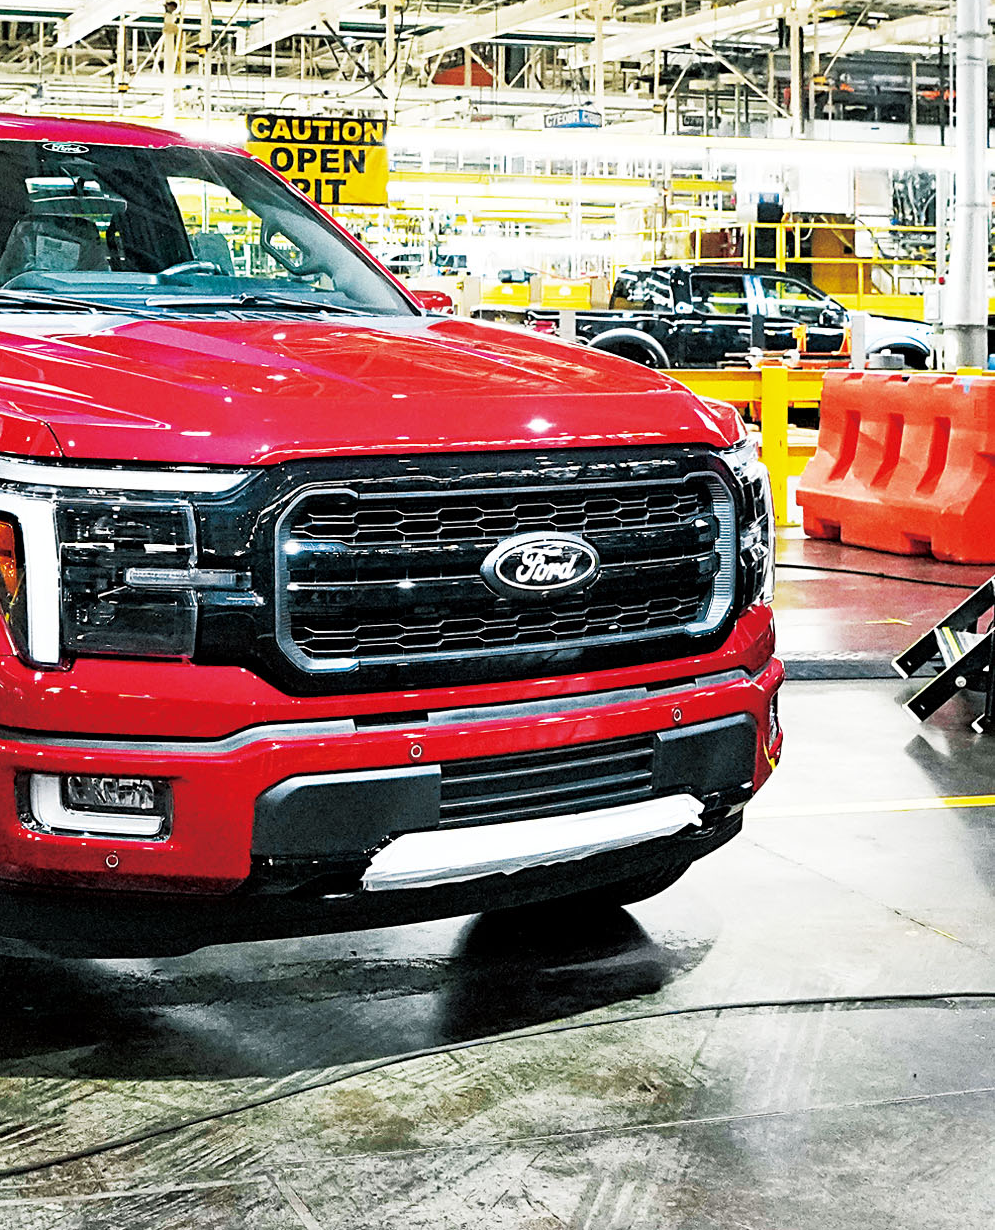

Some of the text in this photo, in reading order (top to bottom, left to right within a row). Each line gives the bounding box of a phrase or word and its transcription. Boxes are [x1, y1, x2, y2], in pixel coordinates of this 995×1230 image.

[250, 117, 384, 143] CAUTION
[270, 147, 366, 174] OPEN
[515, 547, 583, 583] Ford
